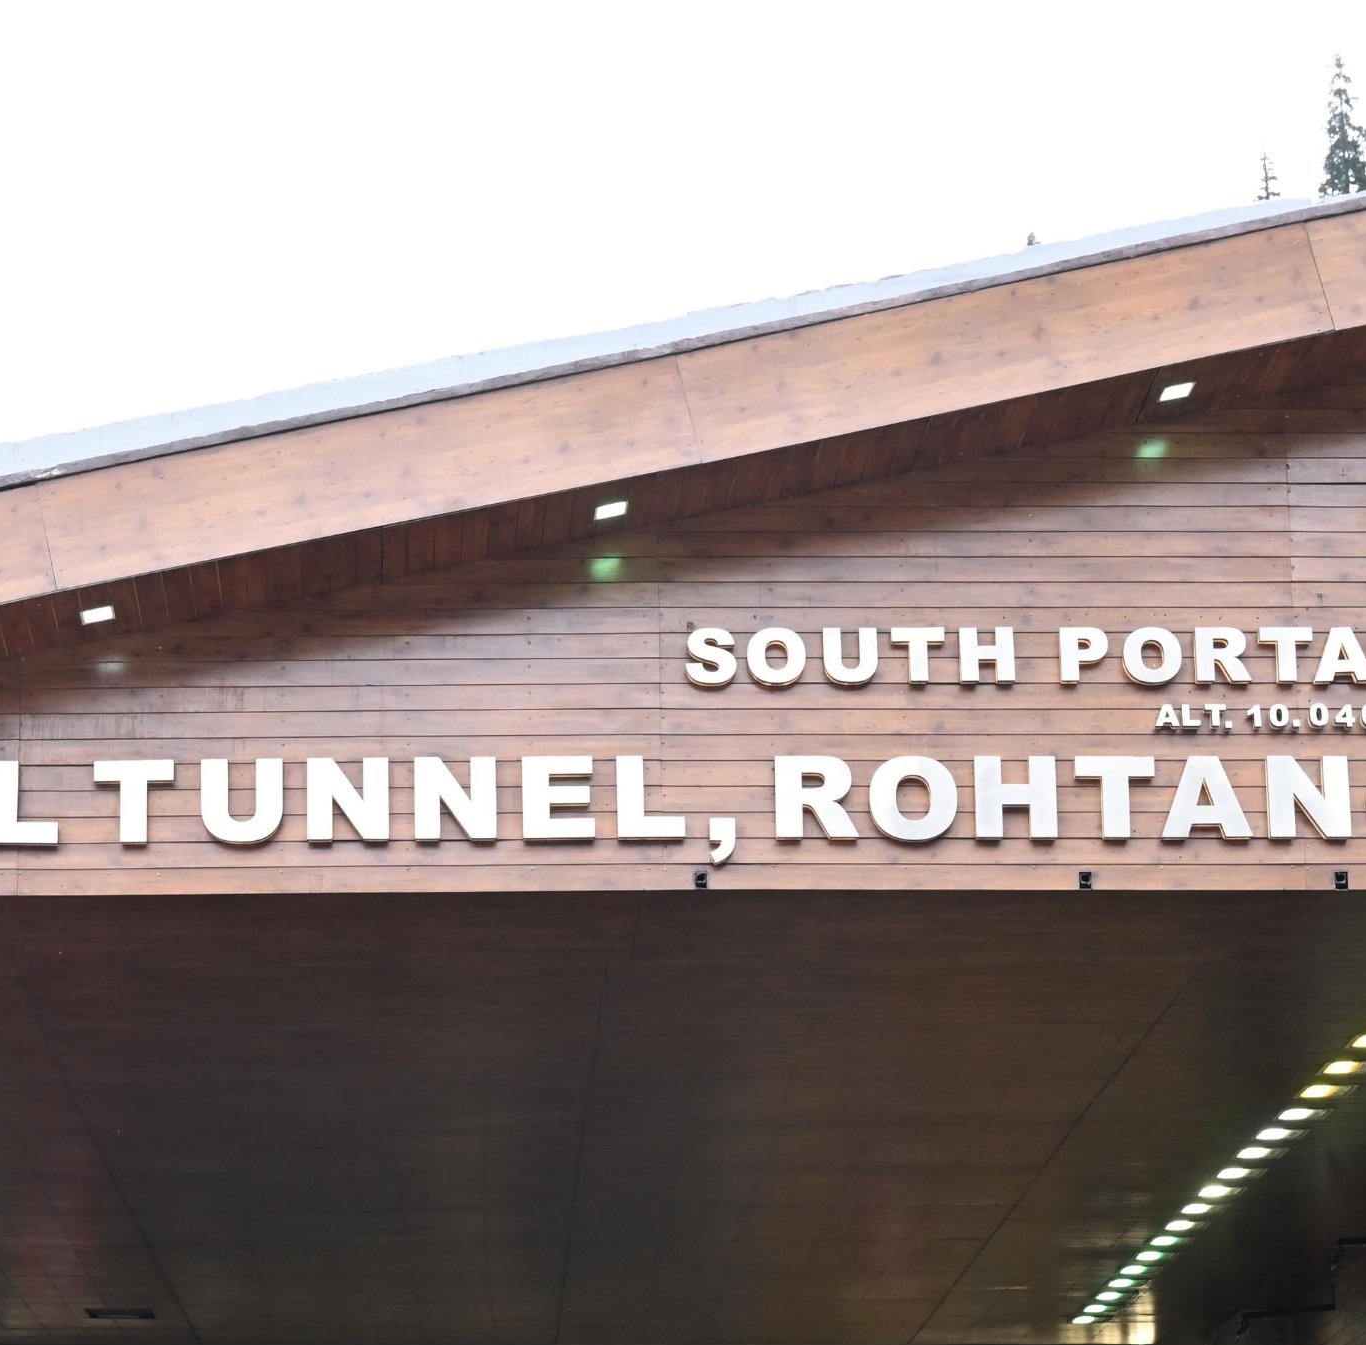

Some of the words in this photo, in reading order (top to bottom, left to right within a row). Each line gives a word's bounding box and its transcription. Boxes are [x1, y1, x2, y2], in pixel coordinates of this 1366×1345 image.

[685, 626, 1017, 687] SOUTH
[1154, 702, 1233, 731] ALT.
[93, 753, 737, 865] TUNNEL,
